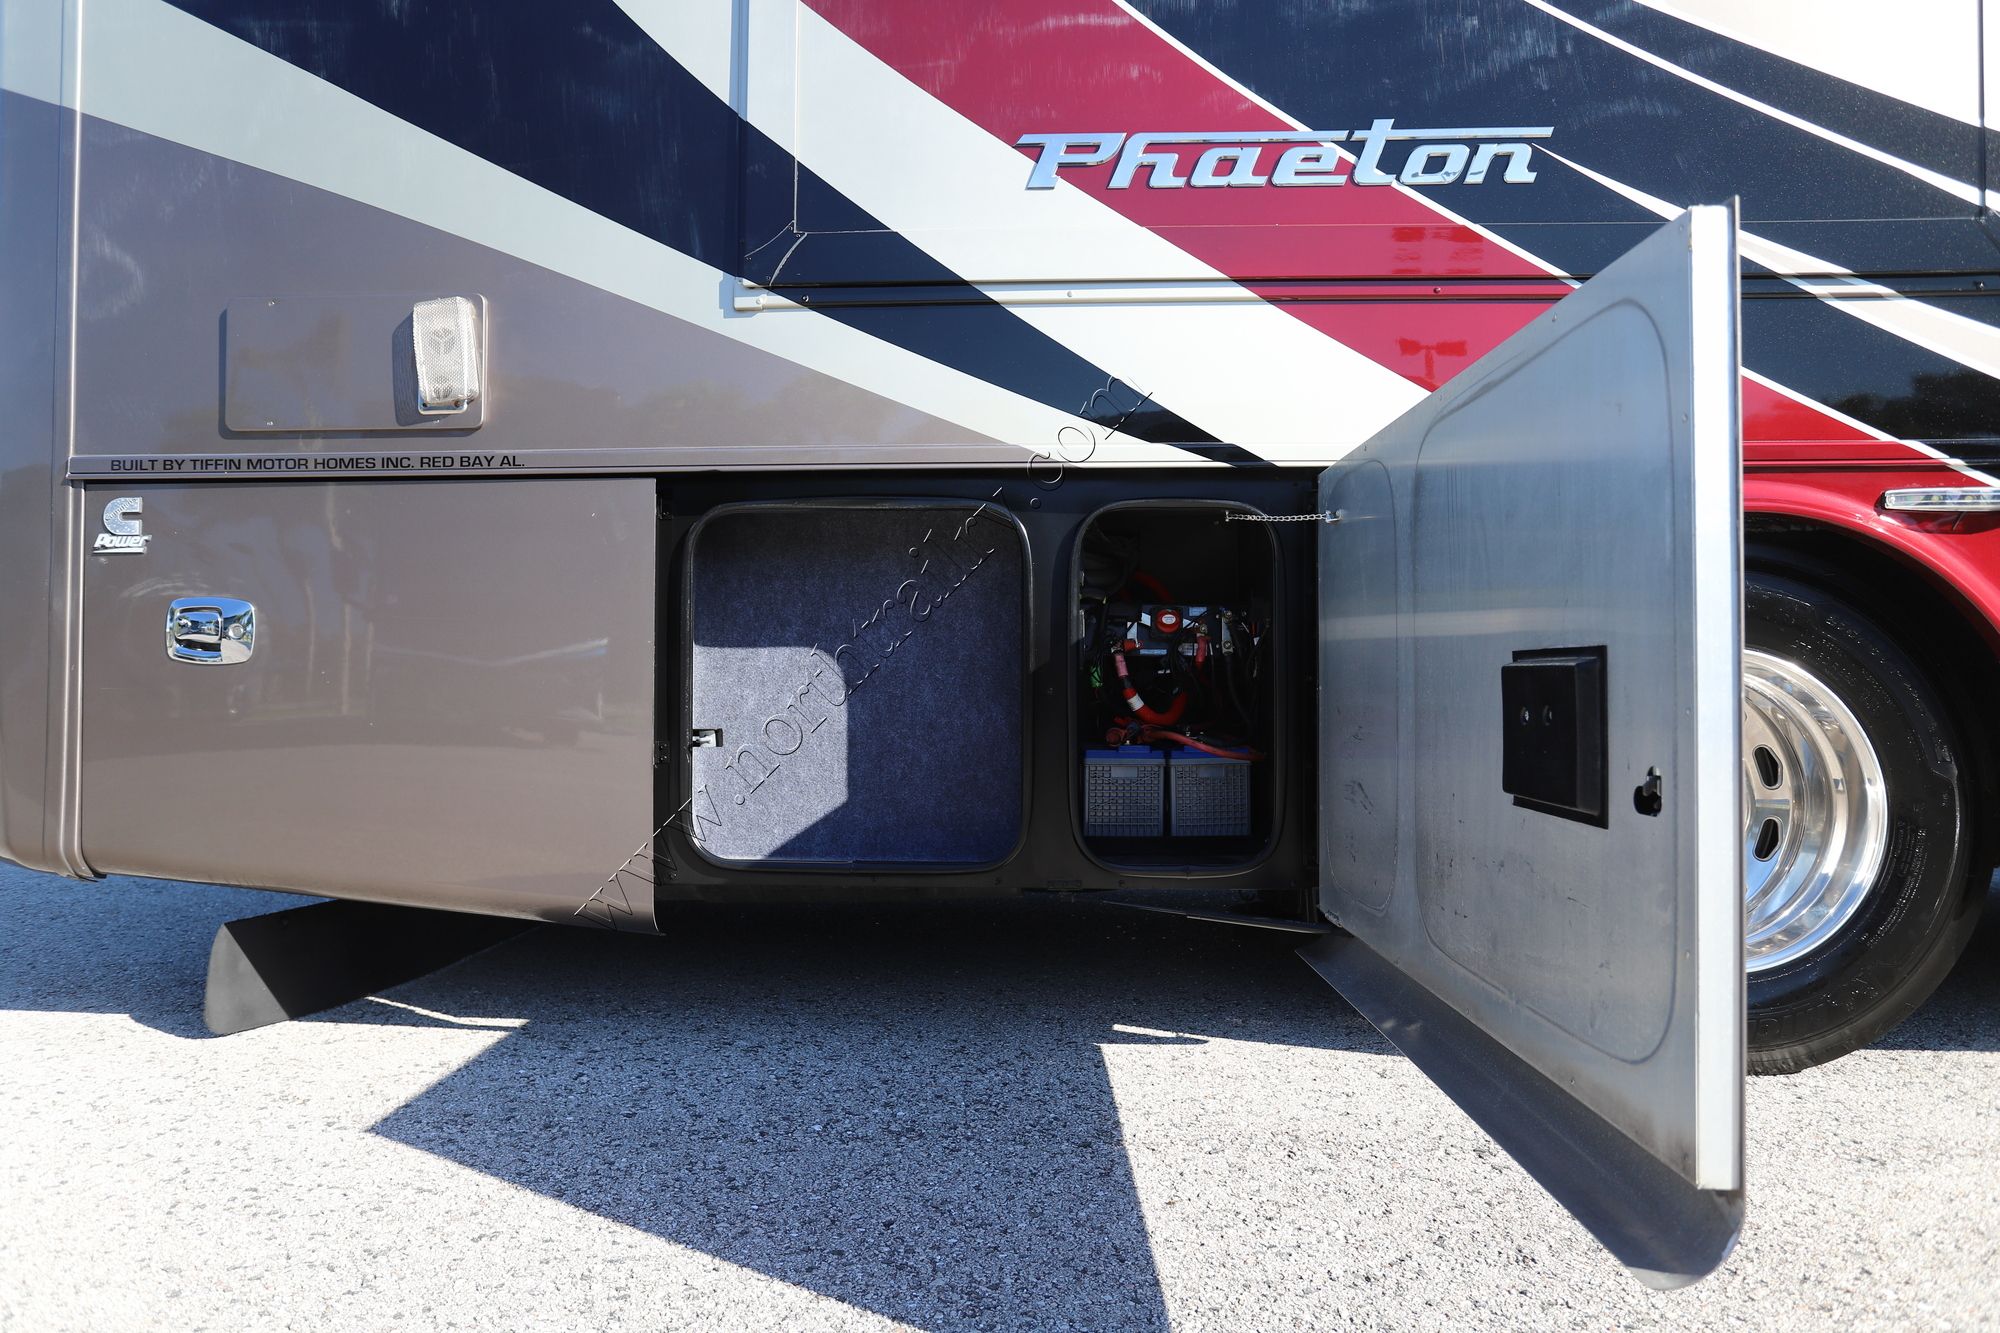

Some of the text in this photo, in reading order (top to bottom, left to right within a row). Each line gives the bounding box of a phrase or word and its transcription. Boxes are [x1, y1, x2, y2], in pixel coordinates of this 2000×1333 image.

[1015, 118, 1554, 190] Phaeton
[110, 455, 525, 471] BUILT BY TIFFIN MOTOR HOMES INC. RED BAY AL.
[93, 533, 152, 548] Power
